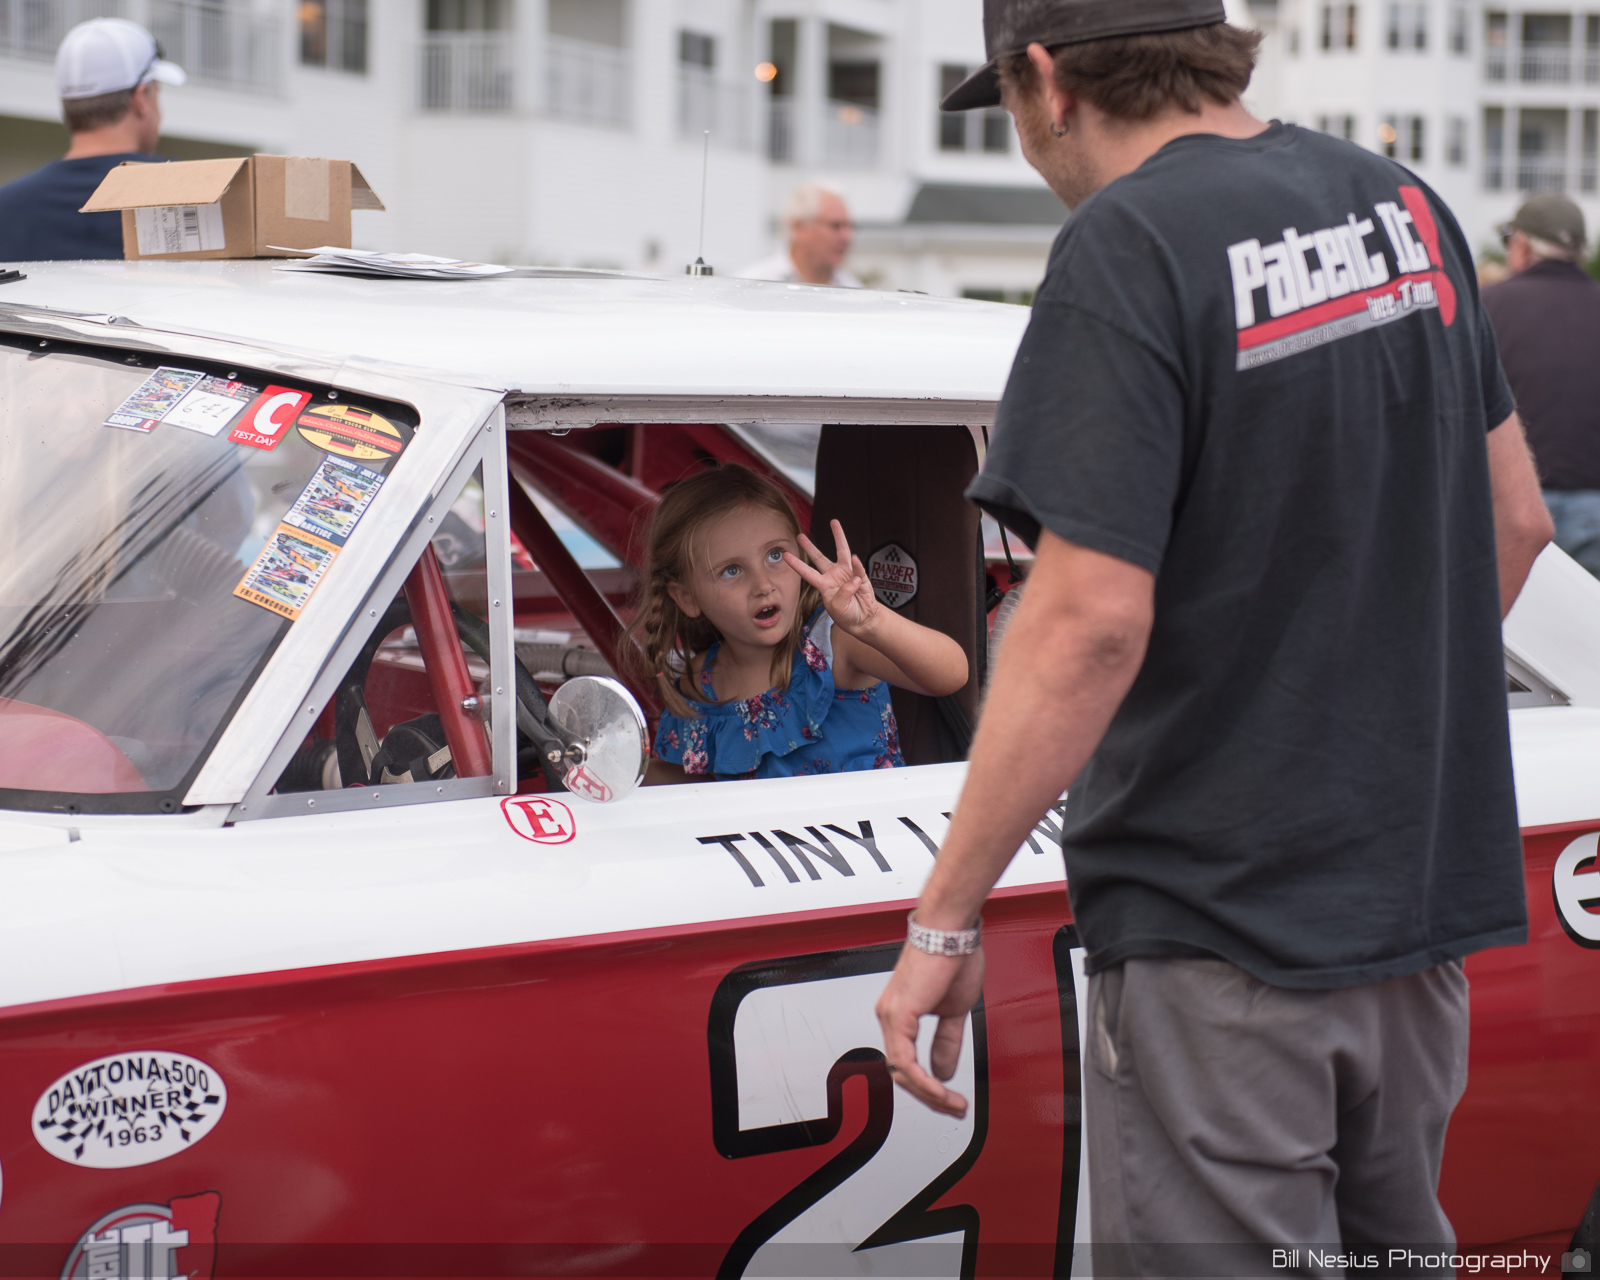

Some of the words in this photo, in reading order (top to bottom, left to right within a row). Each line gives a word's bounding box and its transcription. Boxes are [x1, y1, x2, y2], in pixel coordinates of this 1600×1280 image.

[1227, 212, 1390, 329] Patent
[107, 414, 144, 427] GROUP
[142, 419, 155, 430] 6
[253, 391, 303, 436] C
[233, 429, 256, 441] TEST
[254, 434, 277, 447] DAY
[325, 422, 354, 435] Classic
[354, 430, 400, 450] Automobiles
[326, 454, 358, 472] THURSDAY
[360, 468, 377, 480] JULY
[259, 541, 277, 568] AMERICA
[870, 561, 915, 583] RANDER
[240, 588, 253, 598] FRI
[253, 593, 295, 616] CONCOURS
[509, 799, 568, 839] E
[695, 820, 893, 887] TINY
[48, 1057, 162, 1117] DAYTONA
[171, 1059, 209, 1093] 500
[78, 1089, 183, 1120] WINNER
[103, 1125, 163, 1149] 1963
